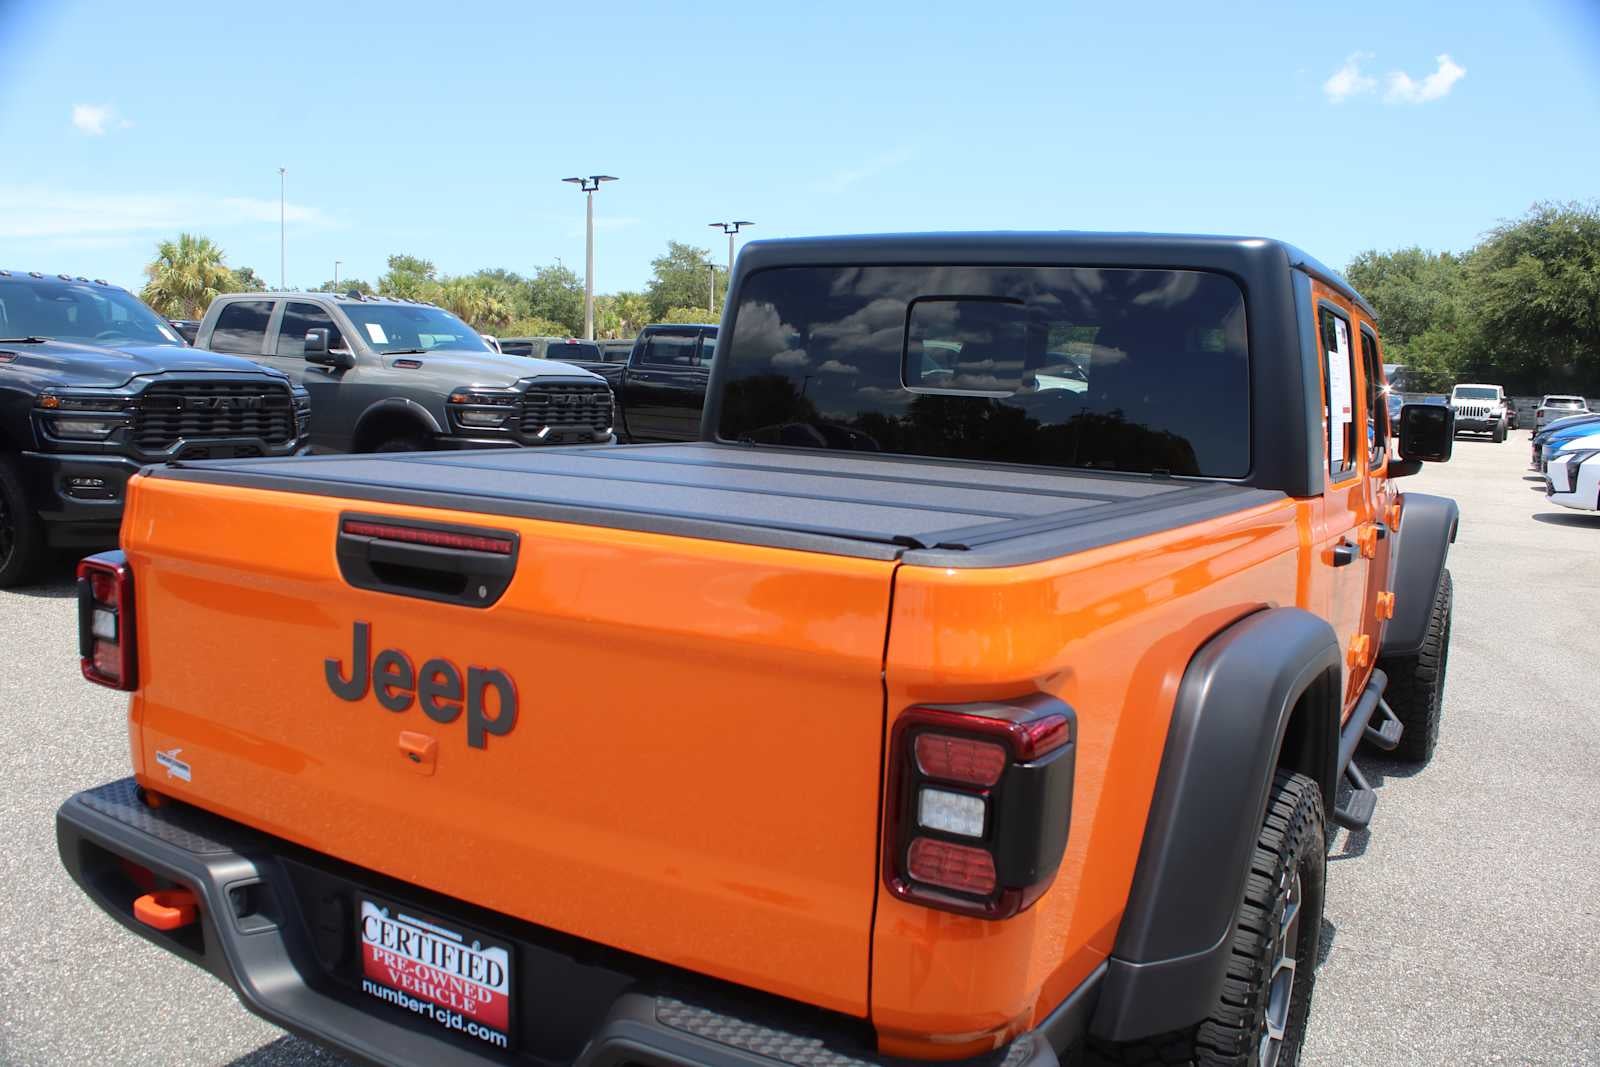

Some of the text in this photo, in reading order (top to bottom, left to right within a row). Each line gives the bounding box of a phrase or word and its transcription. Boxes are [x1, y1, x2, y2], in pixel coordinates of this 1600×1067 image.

[184, 395, 262, 411] RAM
[550, 393, 597, 407] RAM
[325, 620, 518, 750] Jeep
[362, 915, 504, 988] CERTIFIED
[372, 948, 493, 1004] PRE-OWNED
[362, 980, 508, 1048] number1cjd.com
[388, 968, 477, 1014] VEHICLE
